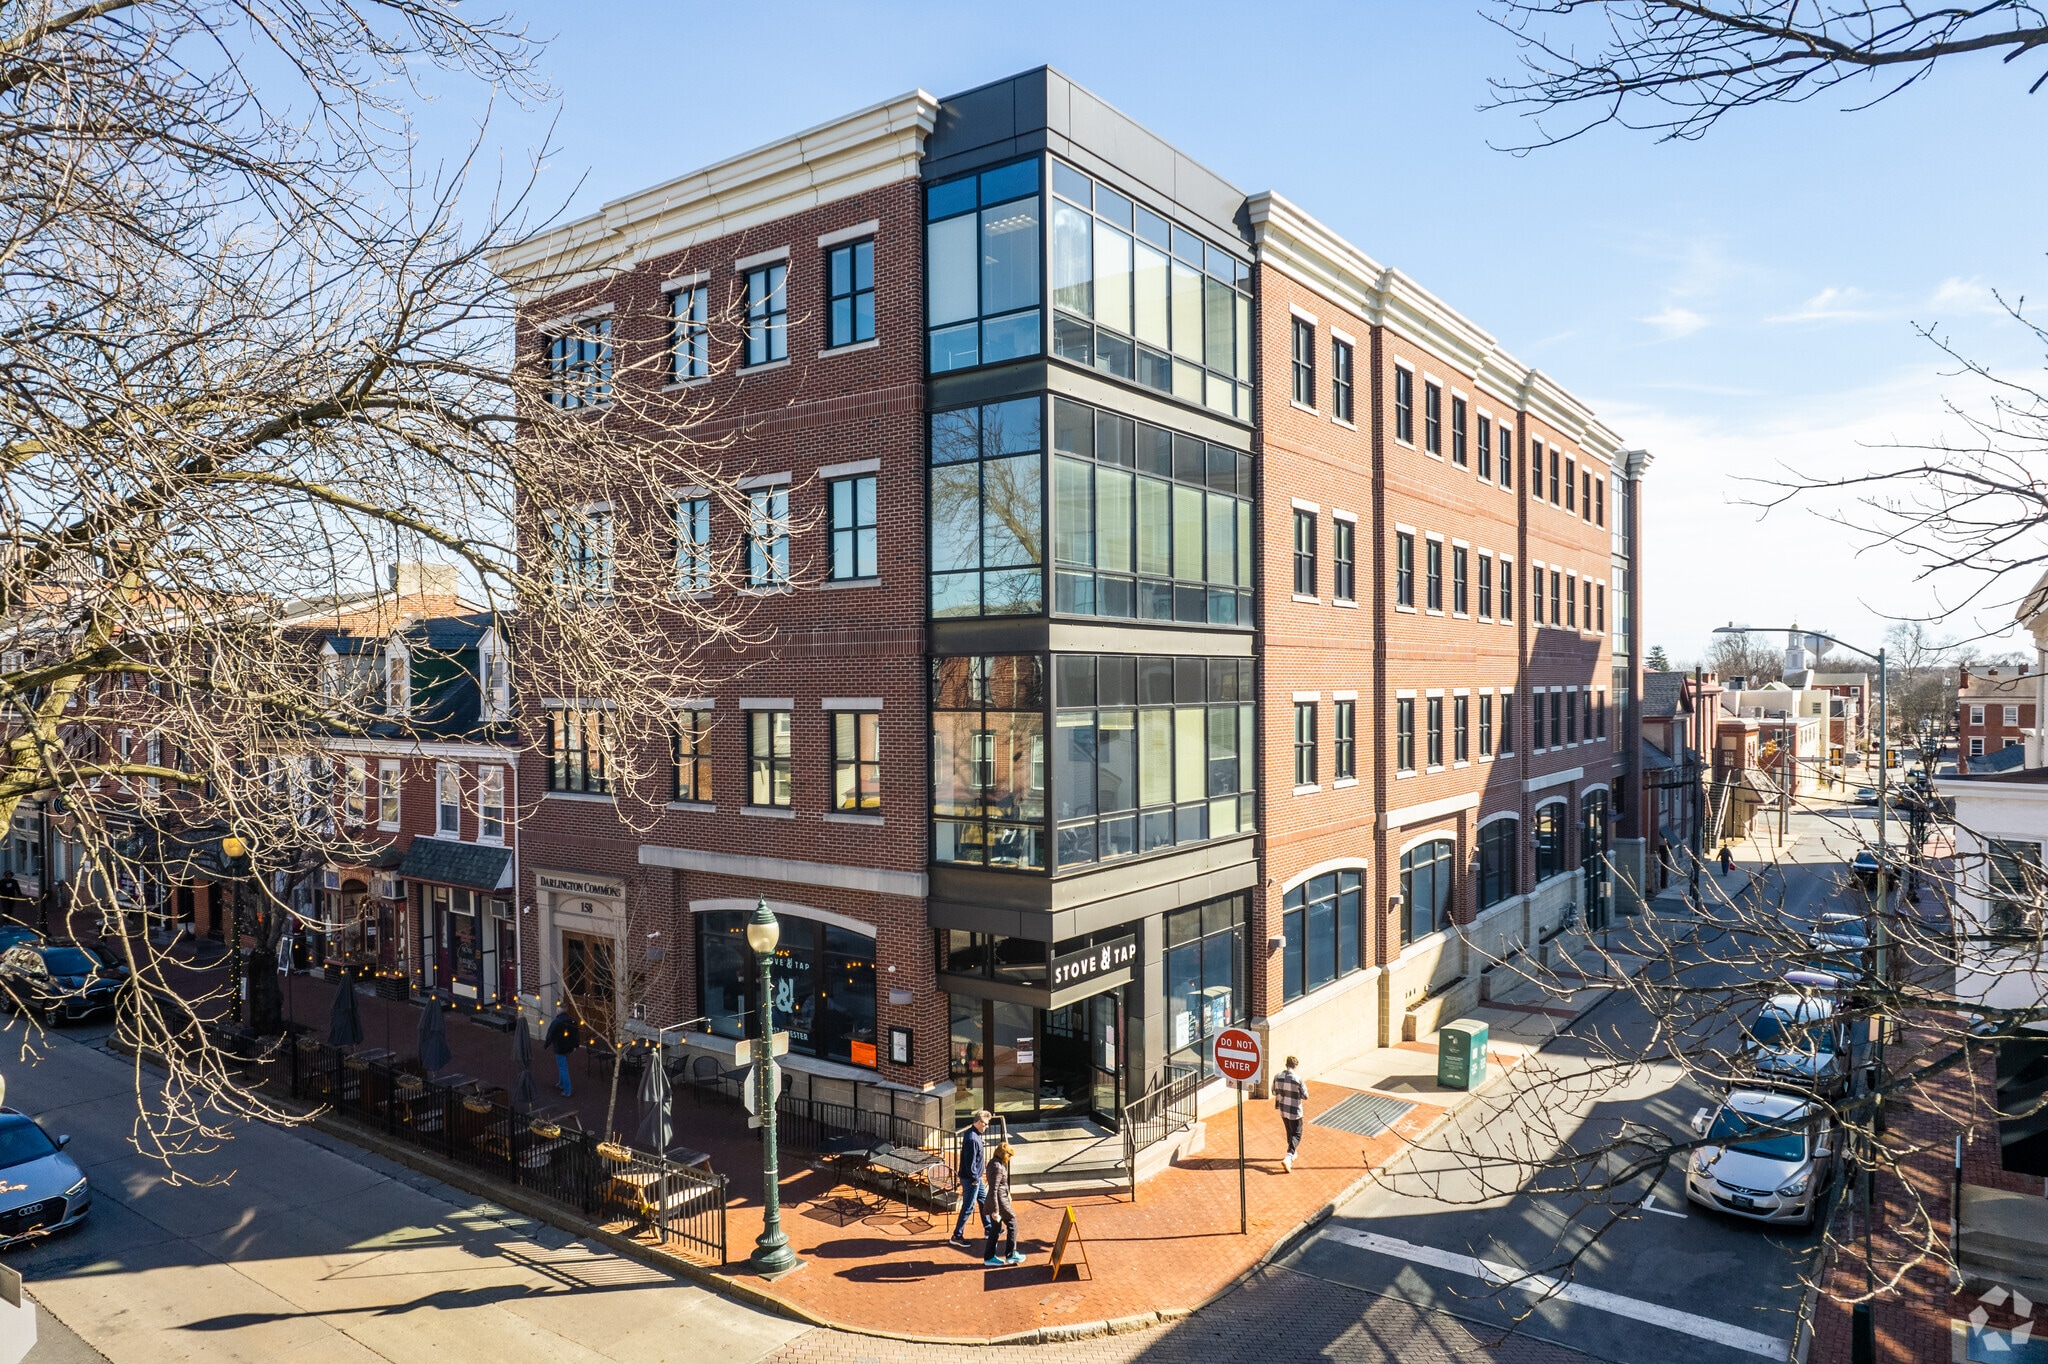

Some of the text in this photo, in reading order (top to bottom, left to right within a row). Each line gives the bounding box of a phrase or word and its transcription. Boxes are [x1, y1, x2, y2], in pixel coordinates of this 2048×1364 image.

[540, 876, 621, 897] DARLINGTON COMMONS
[581, 903, 593, 913] 158
[795, 961, 810, 971] TAP
[1055, 944, 1136, 984] STOVE & TAP
[1221, 1038, 1253, 1050] DO NOT
[1224, 1060, 1250, 1072] ENTER
